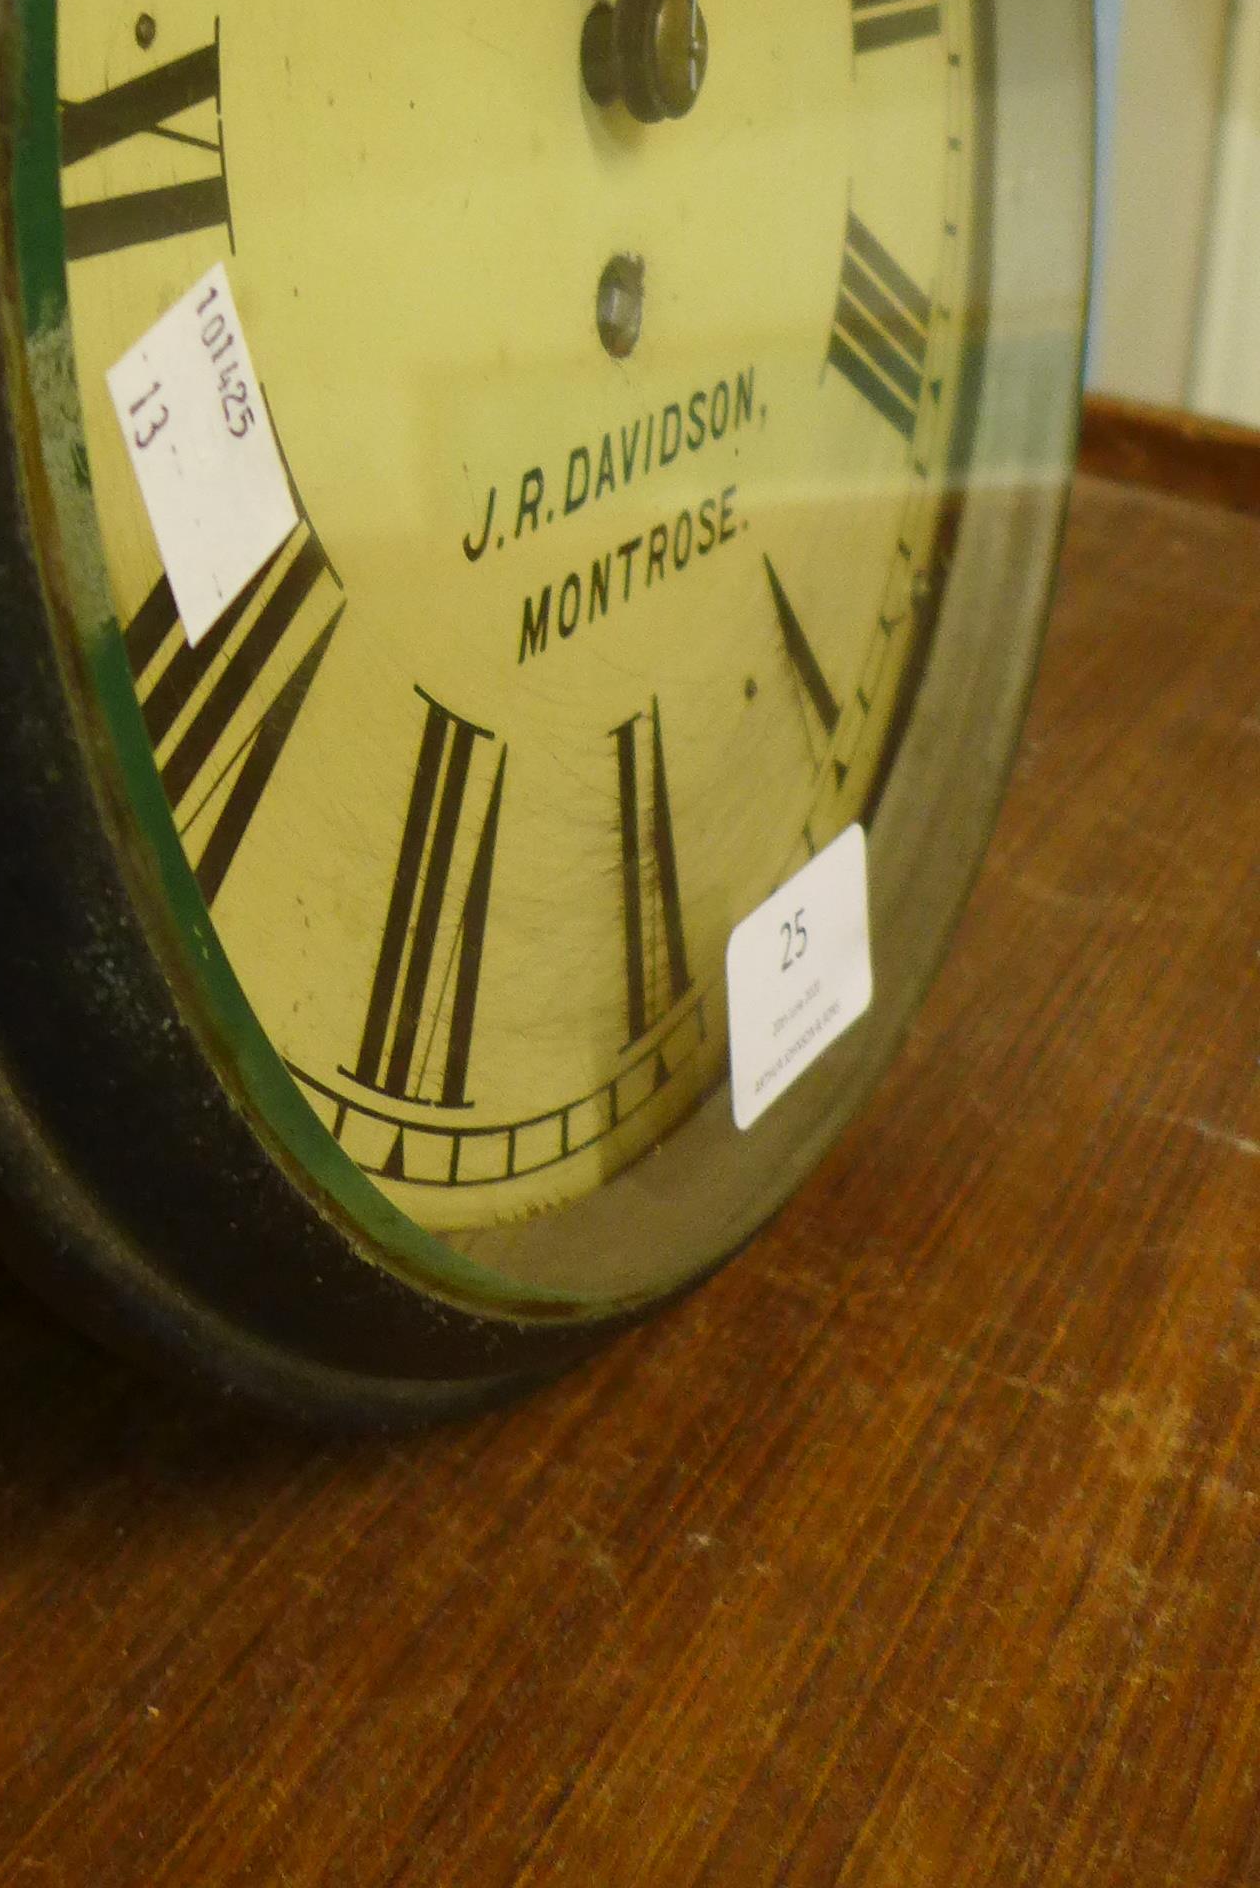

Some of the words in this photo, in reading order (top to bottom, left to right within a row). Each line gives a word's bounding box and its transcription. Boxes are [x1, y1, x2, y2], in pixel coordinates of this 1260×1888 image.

[128, 380, 170, 450] 13
[821, 176, 936, 446] IIII
[517, 483, 750, 665] MONTROSE.
[337, 683, 508, 1110] VII
[607, 694, 696, 1058] VI
[779, 908, 808, 973] 25
